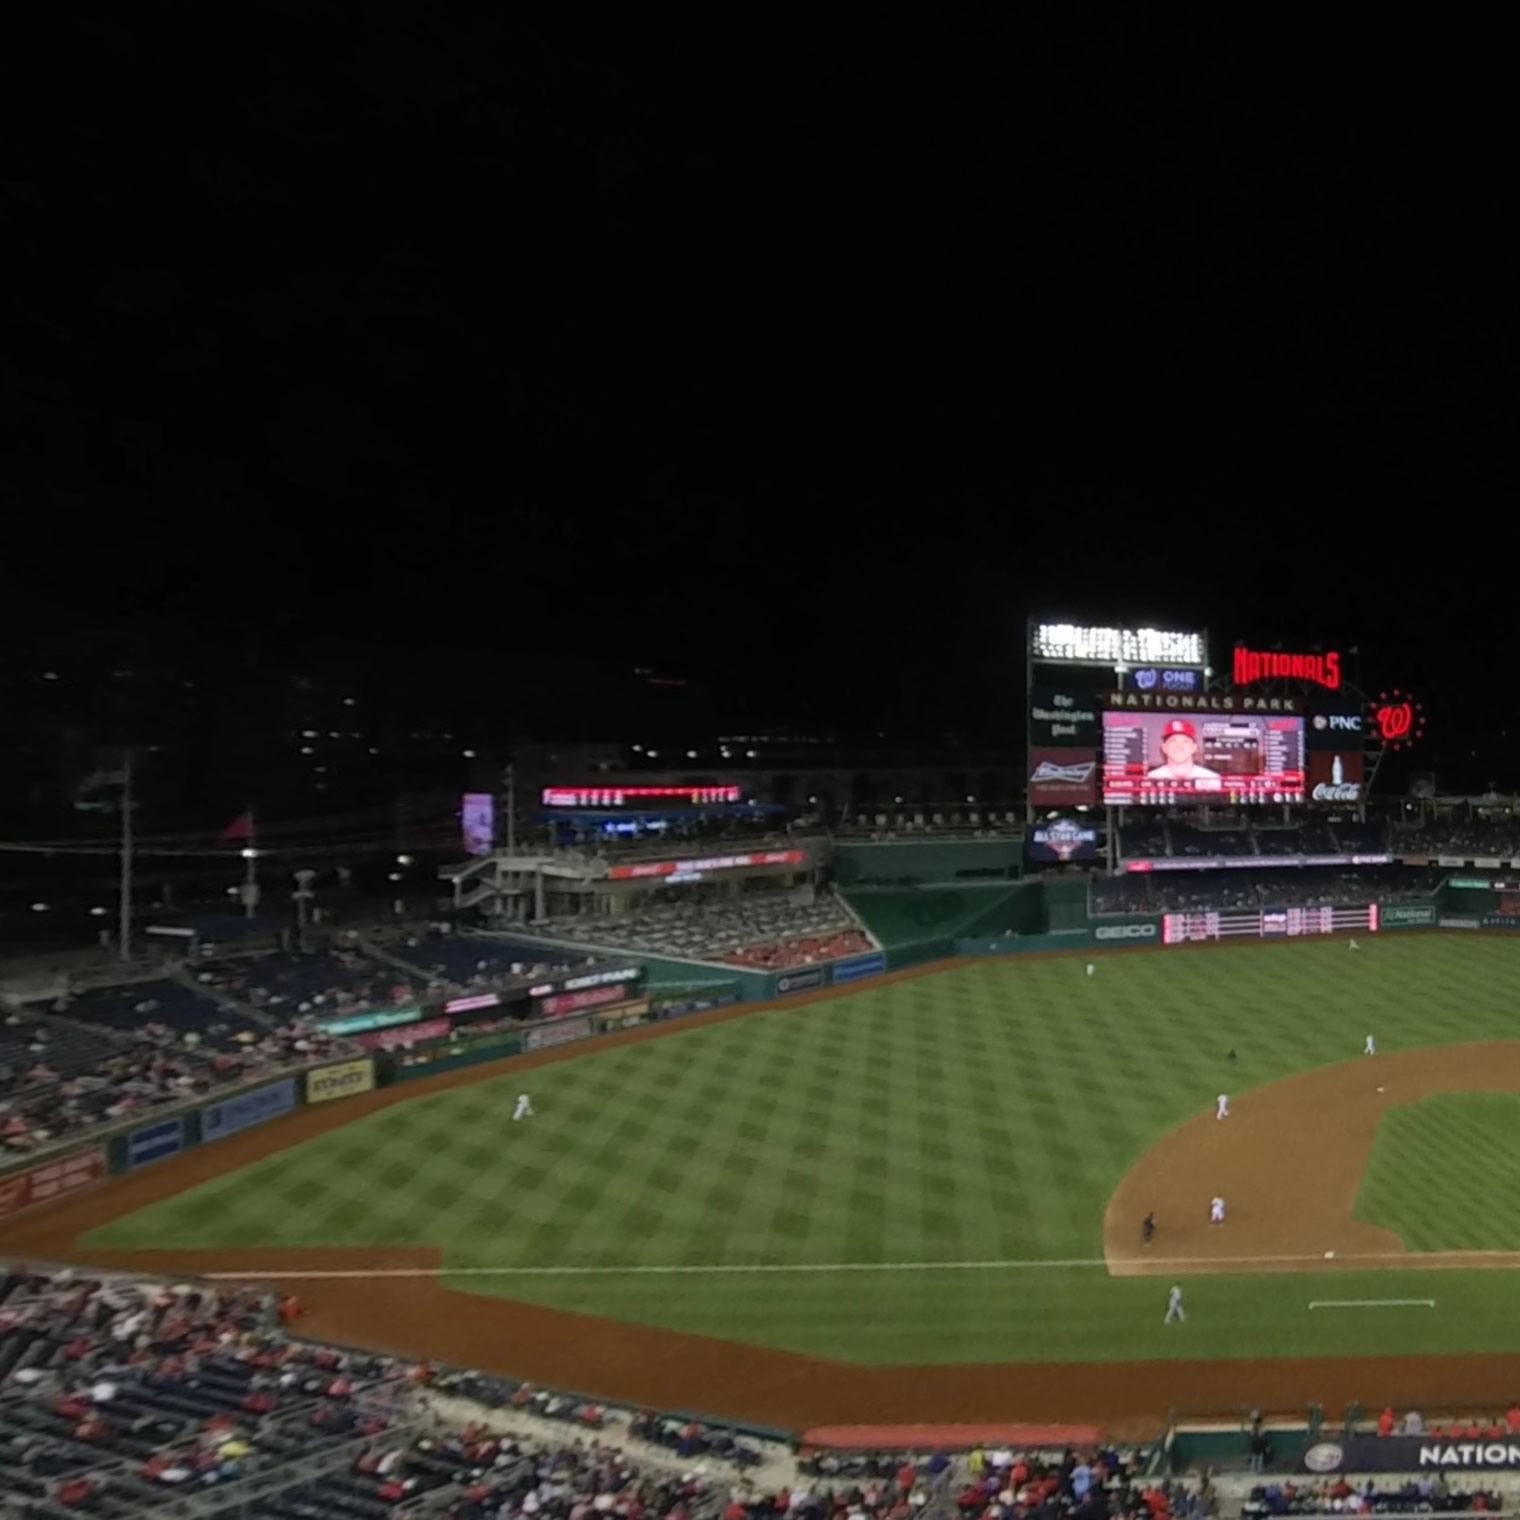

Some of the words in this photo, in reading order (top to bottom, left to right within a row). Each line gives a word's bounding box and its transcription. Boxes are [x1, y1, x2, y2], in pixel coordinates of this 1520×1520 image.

[1163, 671, 1195, 683] ONE
[1234, 649, 1340, 689] NATIONALS
[1110, 693, 1234, 709] NATIONALS
[1243, 697, 1295, 711] PARK
[1329, 715, 1362, 731] PNC
[1095, 924, 1156, 939] GEICO
